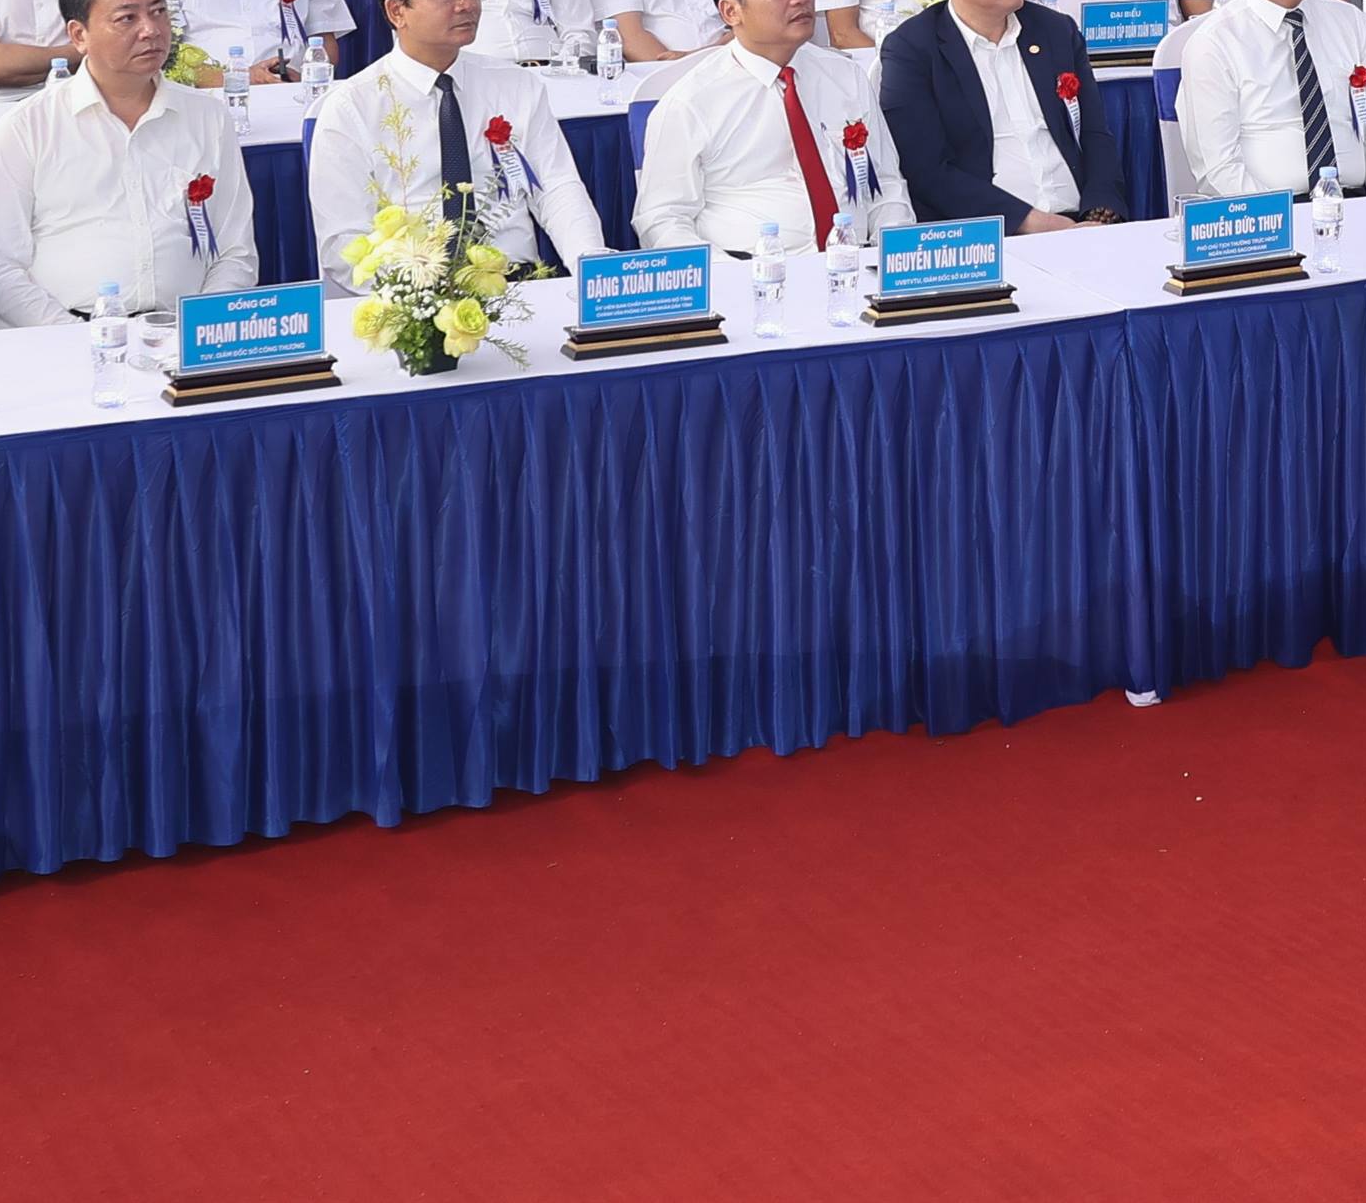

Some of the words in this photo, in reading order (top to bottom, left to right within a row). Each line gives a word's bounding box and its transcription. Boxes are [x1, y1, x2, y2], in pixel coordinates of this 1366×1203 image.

[1110, 11, 1123, 21] ĐẠI
[1124, 7, 1141, 18] BIỂU
[1228, 203, 1247, 213] ÔNG
[920, 230, 946, 241] ĐỒNG
[947, 227, 963, 238] CHÍ
[1191, 216, 1232, 241] NGUYỄN
[1235, 214, 1255, 235] ĐỨC
[1258, 213, 1283, 233] THỤY
[622, 259, 649, 271] ĐỒNG
[651, 256, 667, 267] CHÍ
[886, 244, 931, 274] NGUYỄN
[934, 245, 957, 269] VĂN
[959, 243, 995, 269] LƯỢNG
[587, 275, 619, 303] ĐẶNG
[622, 270, 653, 295] XUÂN
[656, 264, 702, 291] NGUYÊN
[228, 298, 258, 311] ĐỒNG
[259, 295, 277, 307] CHÍ
[196, 321, 236, 348] PHẠM
[240, 312, 277, 341] HỒNG
[280, 312, 308, 336] SƠN
[216, 350, 233, 359] GIÁM
[234, 348, 248, 357] ĐỐC
[249, 347, 258, 355] SỞ
[259, 345, 277, 354] CÔNG
[279, 342, 306, 351] THƯƠNG
